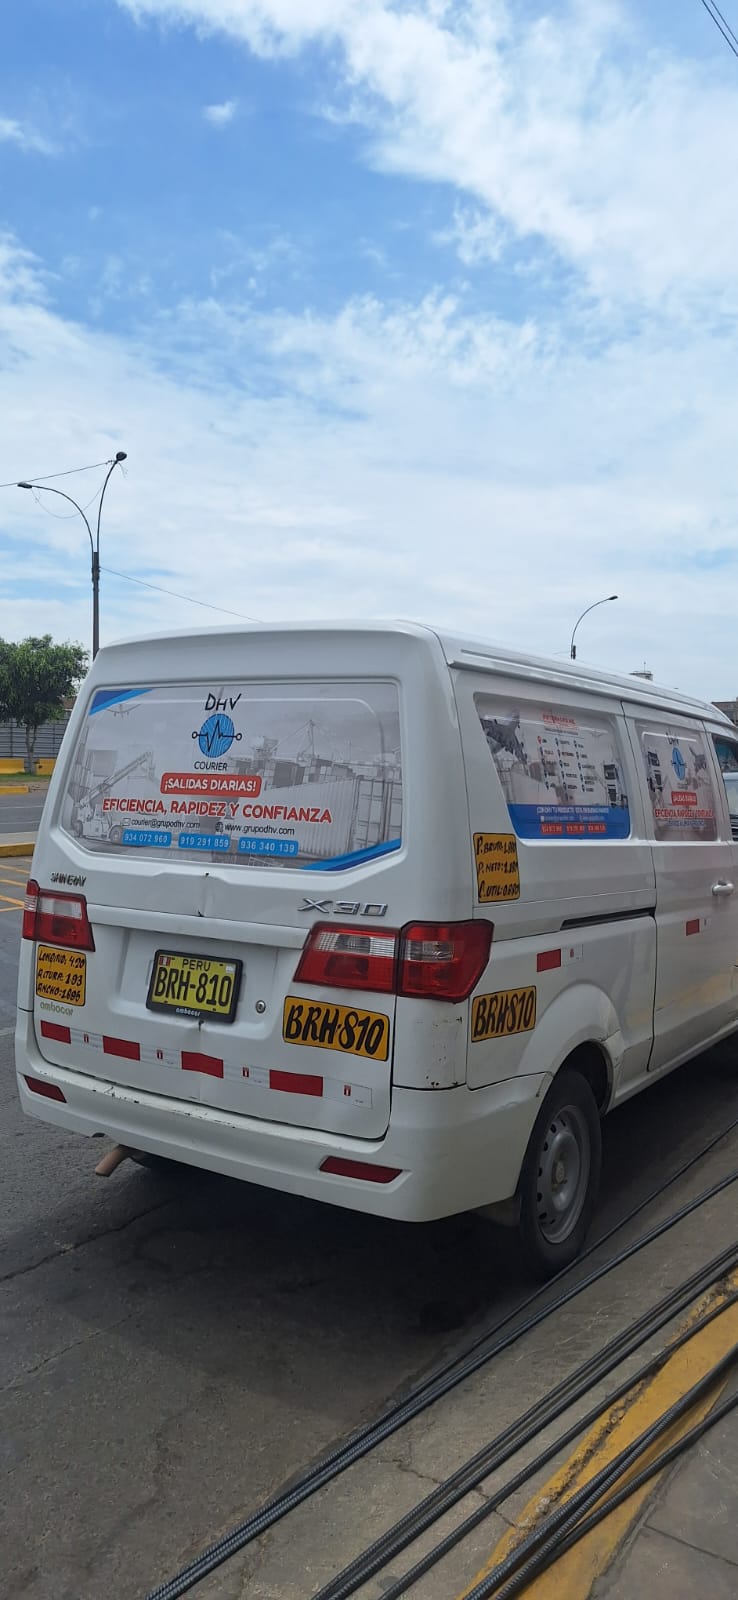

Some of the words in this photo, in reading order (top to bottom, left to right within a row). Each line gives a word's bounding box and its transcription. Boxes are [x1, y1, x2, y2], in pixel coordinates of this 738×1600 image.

[204, 693, 242, 712] DHV
[194, 761, 227, 771] COURIER
[164, 777, 208, 791] ¡SALIDAS
[210, 779, 257, 792] DIARIAS!
[103, 799, 167, 815] EFICIENCIA,
[170, 801, 226, 816] RAPIDEZ
[230, 804, 240, 817] Y
[243, 805, 332, 823] CONFIANZA
[131, 819, 200, 830] courier@grupodhv.com
[225, 824, 295, 835] www.grupodhv.com
[124, 833, 138, 842] 934
[180, 836, 195, 845] 919
[197, 838, 212, 846] 291
[214, 839, 229, 848] 859
[240, 841, 257, 850] 936
[259, 842, 275, 851] 340
[279, 843, 295, 853] 139
[298, 898, 389, 917] X30
[69, 955, 85, 968] 4.20
[182, 958, 212, 972] PERU
[154, 966, 232, 1007] BRH-810
[285, 1004, 385, 1056] BRH-810
